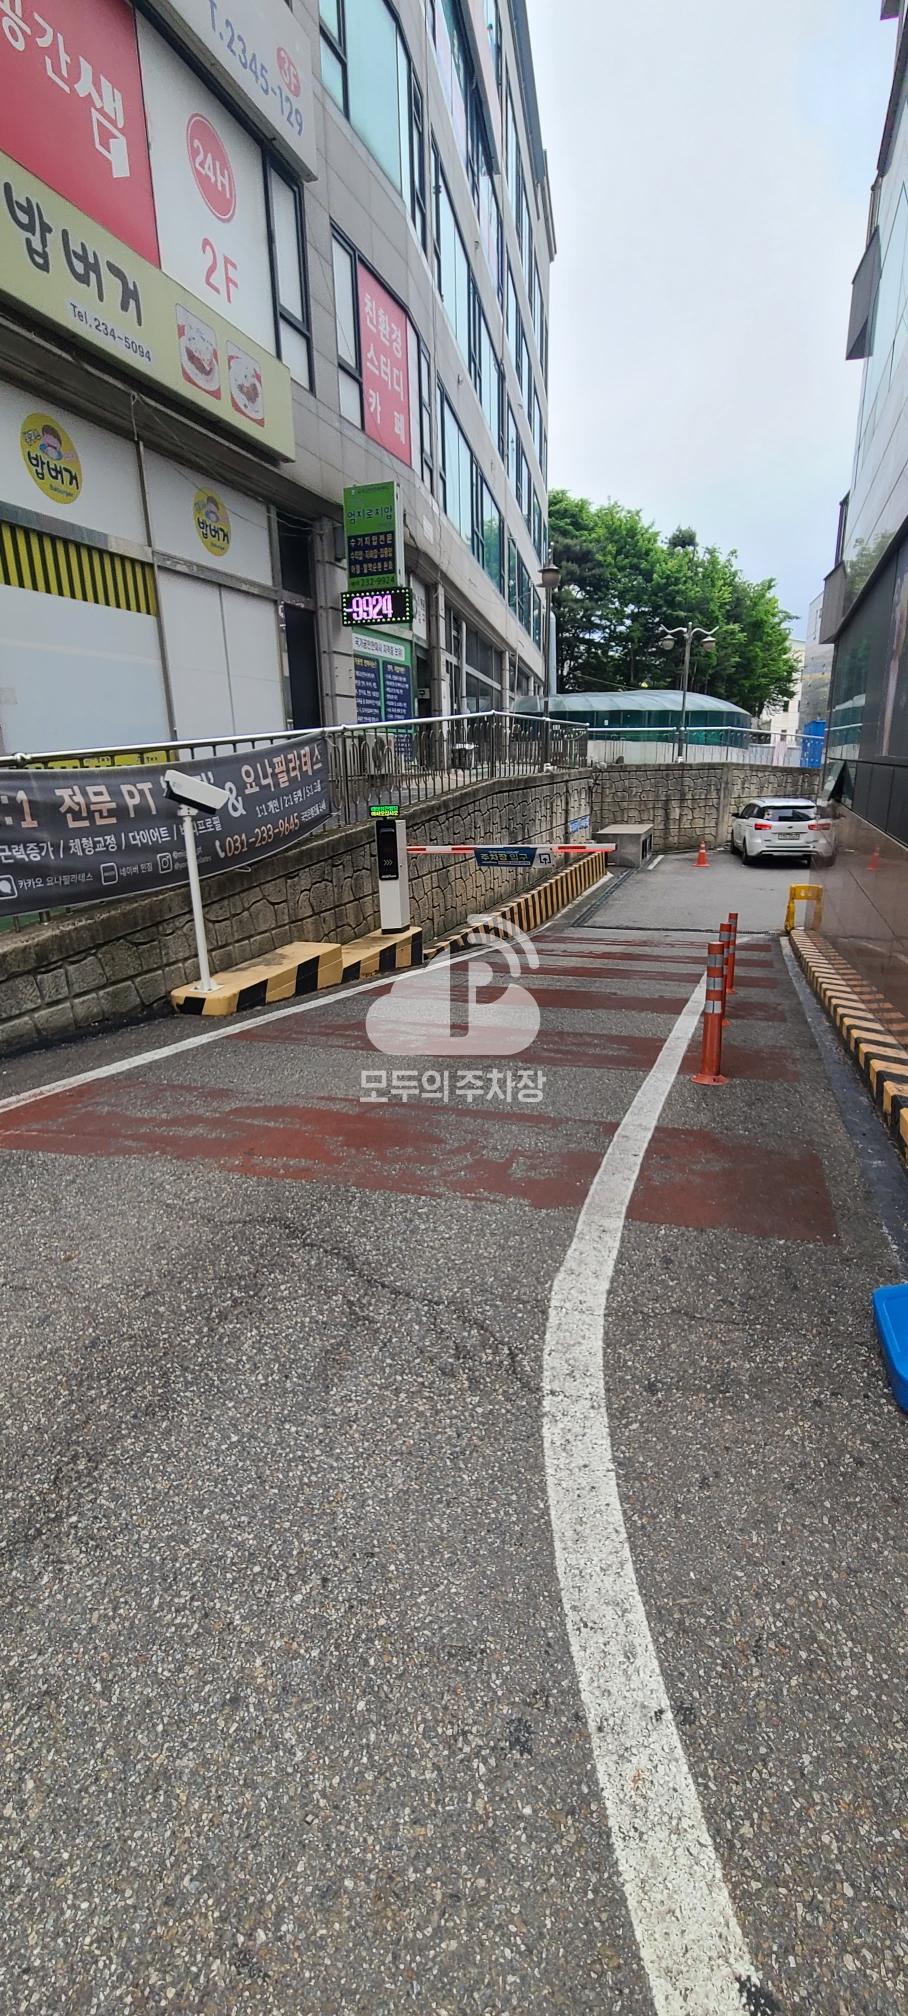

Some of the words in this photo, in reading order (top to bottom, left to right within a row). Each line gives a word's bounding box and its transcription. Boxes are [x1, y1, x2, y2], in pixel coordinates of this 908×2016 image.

[279, 50, 299, 92] 3F
[193, 139, 230, 199] 24H
[4, 182, 142, 327] 밥버거
[202, 238, 239, 304] 2F
[70, 302, 151, 362] Tel.234-5094
[364, 294, 402, 358] 친환경
[366, 344, 404, 401] 스터디
[28, 451, 79, 490] 밥버거
[197, 517, 229, 544] 밥버거
[347, 505, 392, 525] 엄지로지압
[54, 785, 117, 828] 전문
[120, 782, 156, 818] PT
[224, 781, 246, 818] &
[241, 744, 322, 795] 요나필라테스
[256, 804, 267, 818] 1:1
[267, 800, 281, 814] 개인
[283, 794, 293, 808] 2:1
[0, 841, 54, 863] 근력증가
[69, 834, 117, 856] 체형교정
[128, 827, 171, 847] 다이어트
[226, 812, 300, 857] 031-233-9645
[18, 877, 44, 890] 카카오
[120, 865, 139, 877] 네이버
[480, 853, 507, 861] 주차장
[509, 853, 528, 861] 입구
